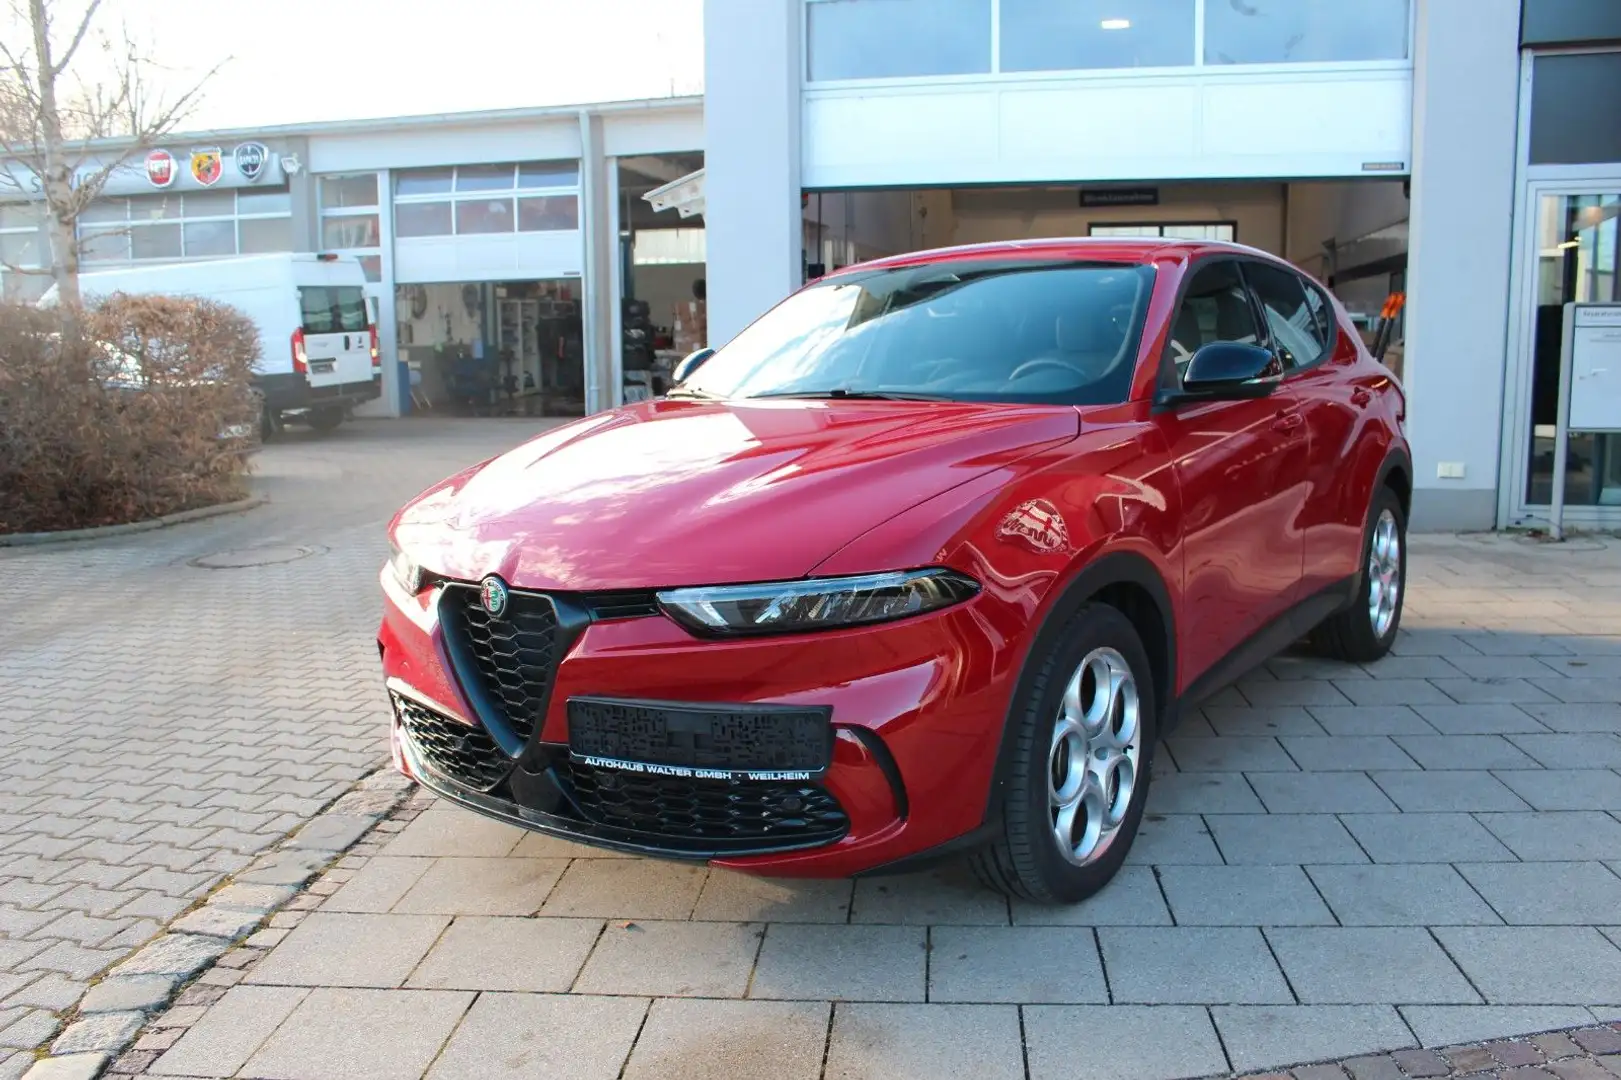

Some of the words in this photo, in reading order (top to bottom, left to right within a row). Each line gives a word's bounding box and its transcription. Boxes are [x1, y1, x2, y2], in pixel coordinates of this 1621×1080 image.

[584, 757, 644, 773] AUTOHAUS
[646, 765, 692, 778] WALTER
[695, 771, 732, 780] GMBH
[748, 772, 810, 781] WEILHEIM
